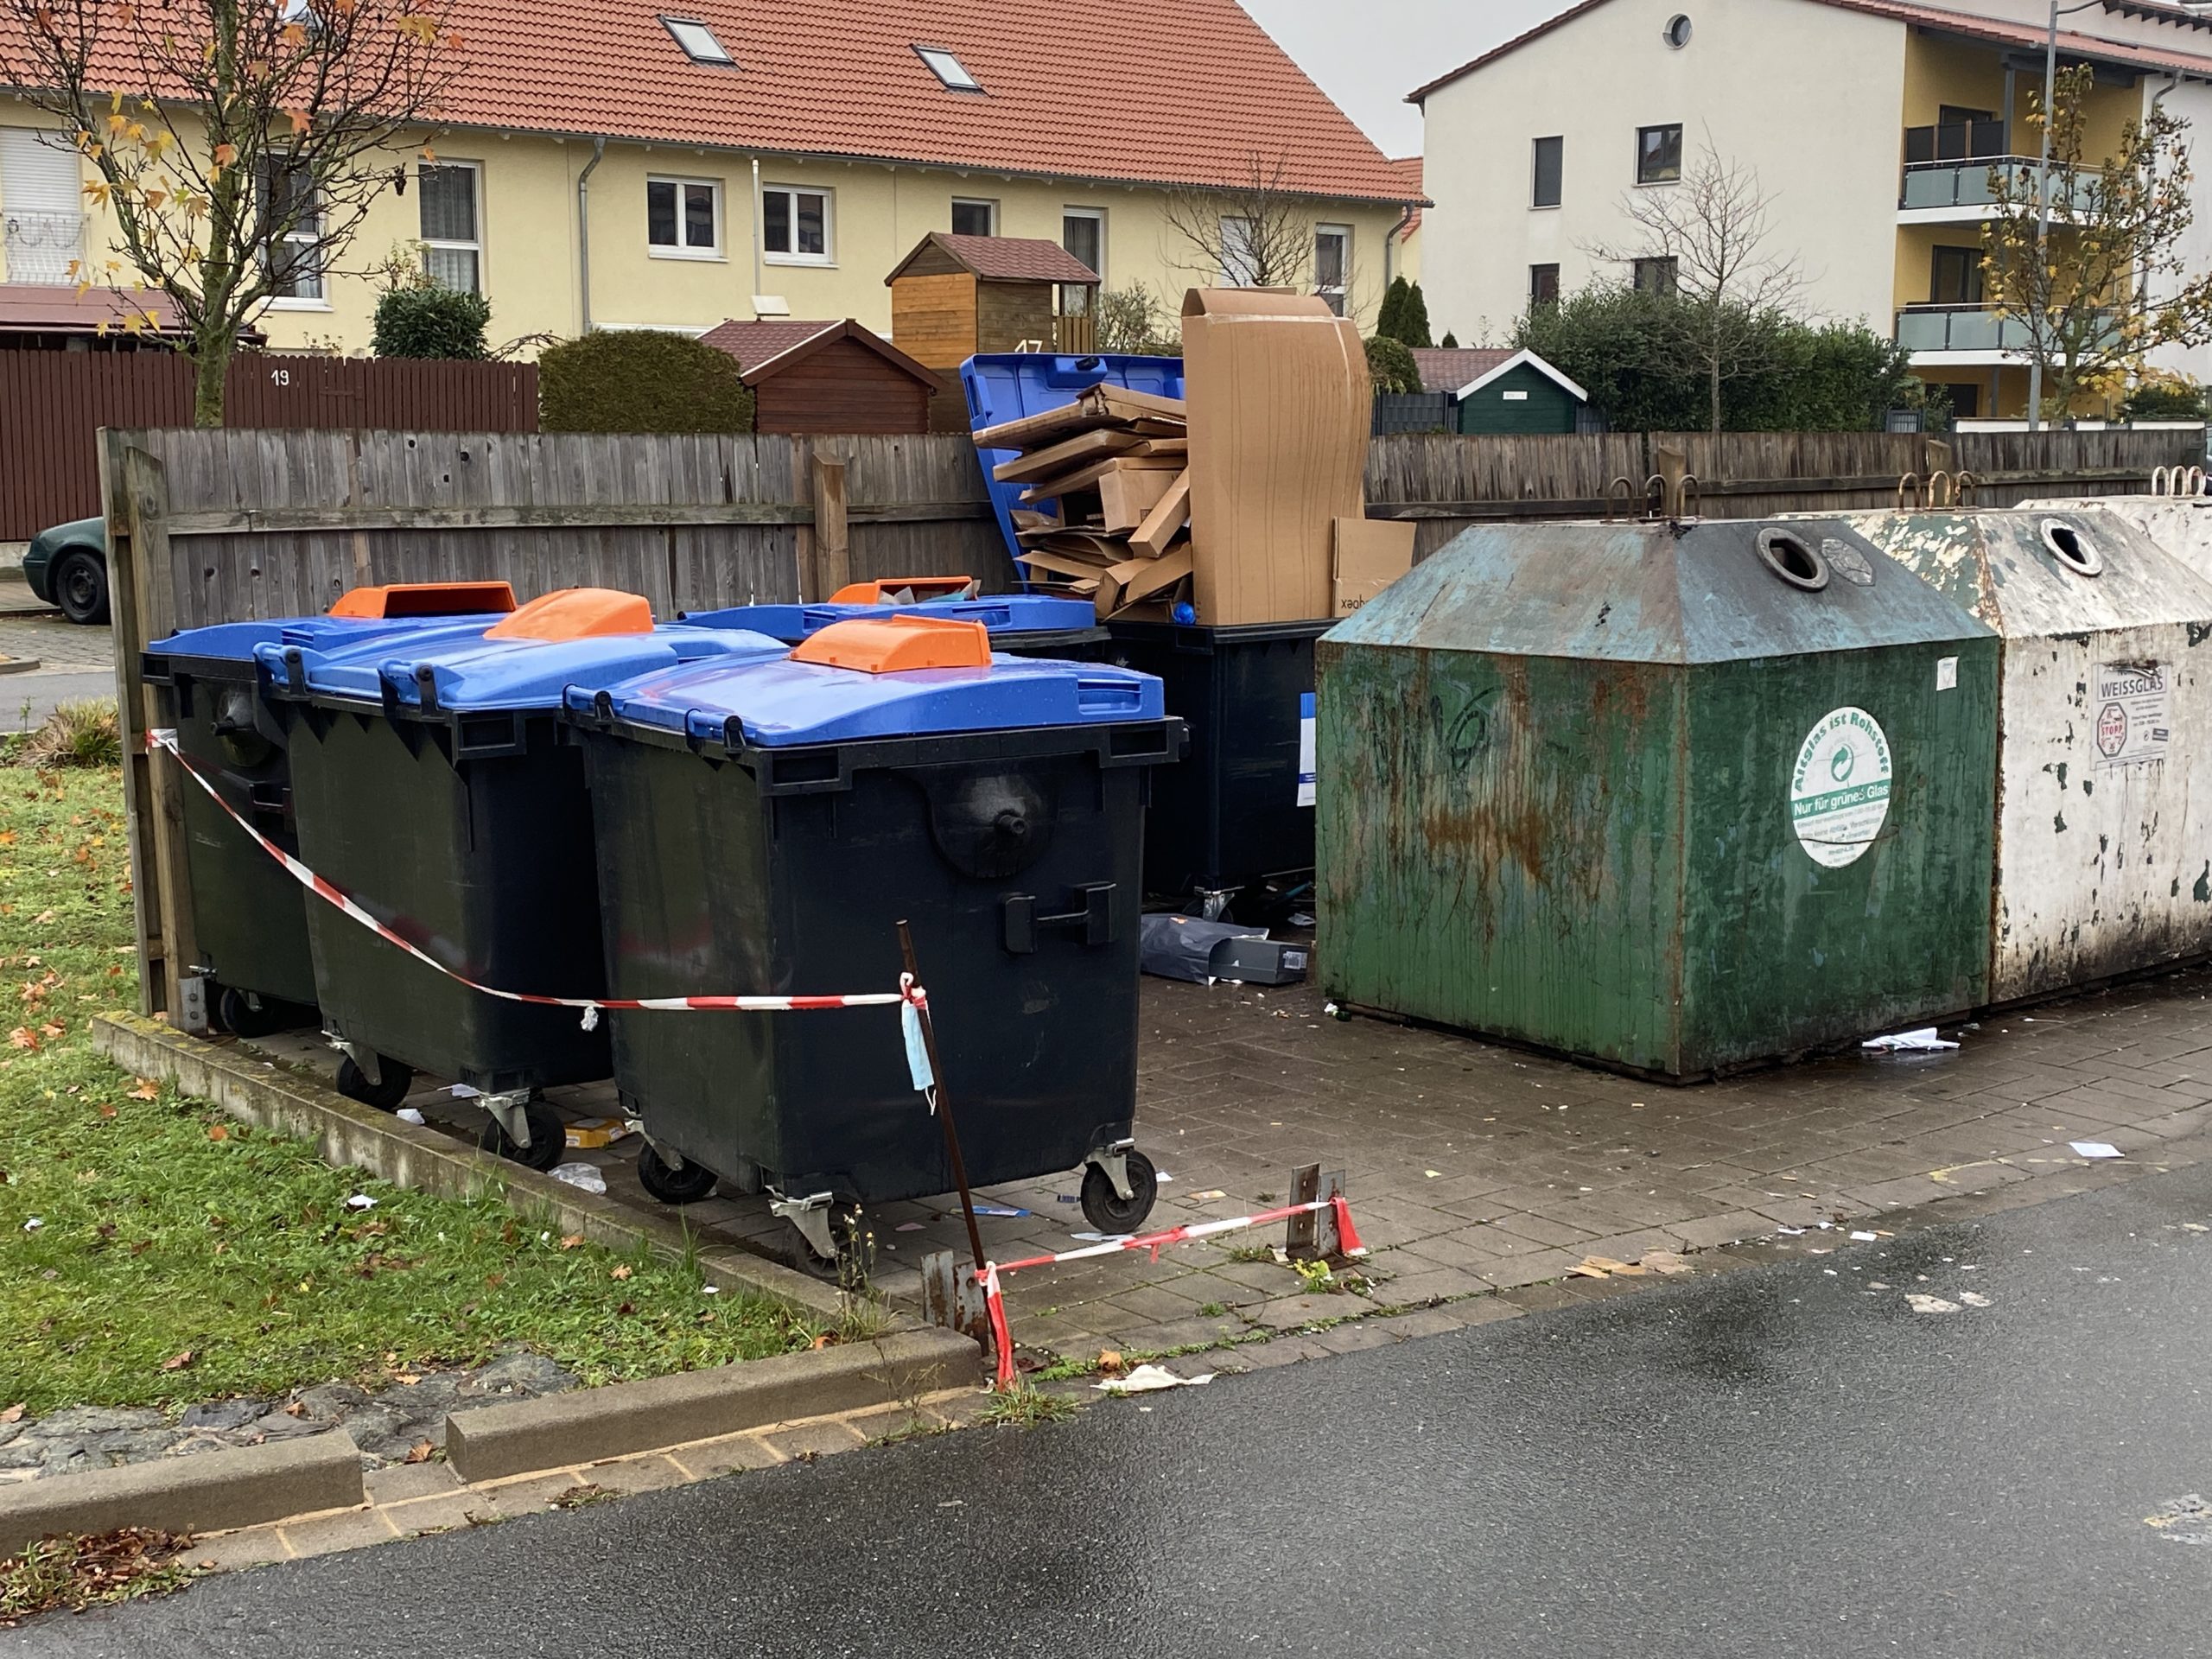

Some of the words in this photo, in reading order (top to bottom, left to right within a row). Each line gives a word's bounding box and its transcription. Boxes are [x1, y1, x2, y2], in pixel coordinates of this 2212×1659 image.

[1014, 339, 1043, 353] 17
[270, 369, 289, 386] 19
[2101, 677, 2163, 697] WEISSGLAS
[2101, 724, 2122, 736] STOPP
[1794, 726, 1827, 792] Altglas
[1829, 713, 1847, 729] ist
[1850, 712, 1889, 773] Rohstoff
[1794, 802, 1813, 816] Nur
[1815, 796, 1829, 810] für
[1830, 790, 1865, 810] grünes
[1867, 784, 1889, 798] Glas
